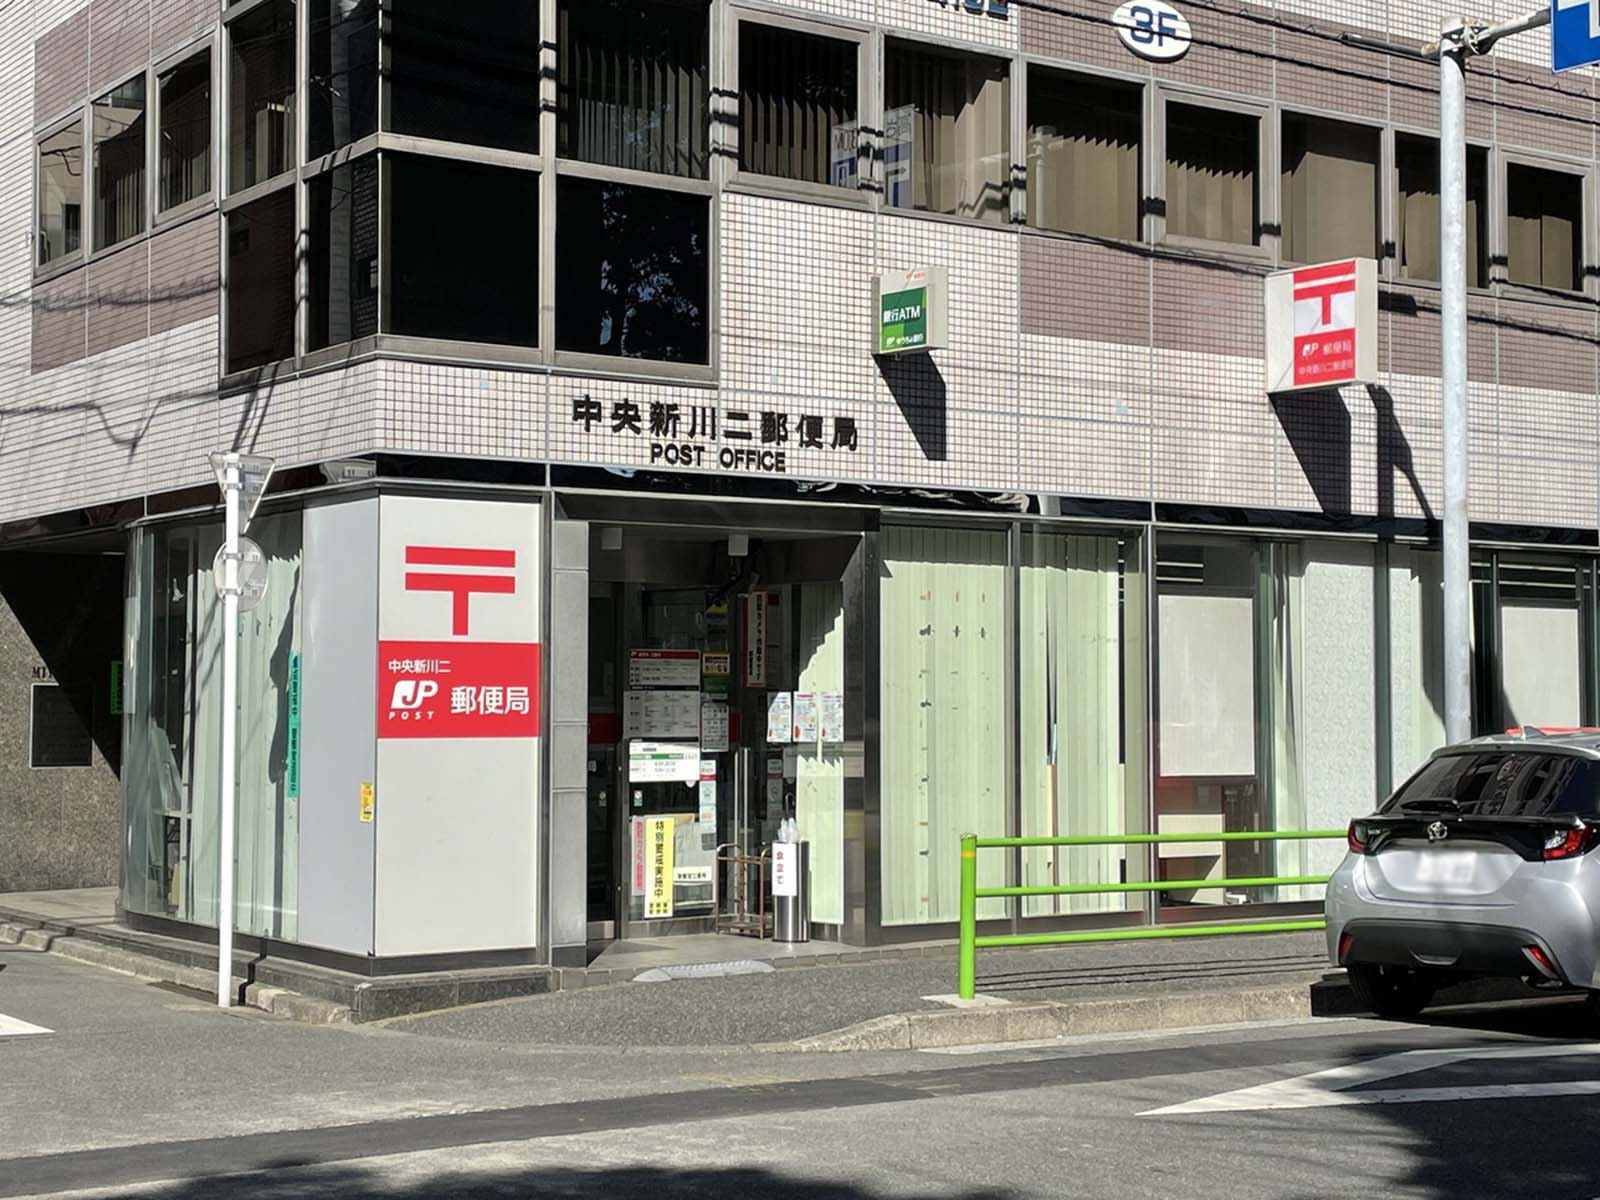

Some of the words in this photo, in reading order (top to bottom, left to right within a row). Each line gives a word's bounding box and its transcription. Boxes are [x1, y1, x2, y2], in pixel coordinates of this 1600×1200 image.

[1130, 5, 1178, 47] 3F
[572, 394, 858, 452] 中央新川二郵便局
[651, 443, 705, 467] POST
[719, 448, 786, 472] OFFICE
[388, 659, 451, 674] 中央新川二
[450, 686, 530, 715] 郵便局
[388, 711, 435, 720] POST
